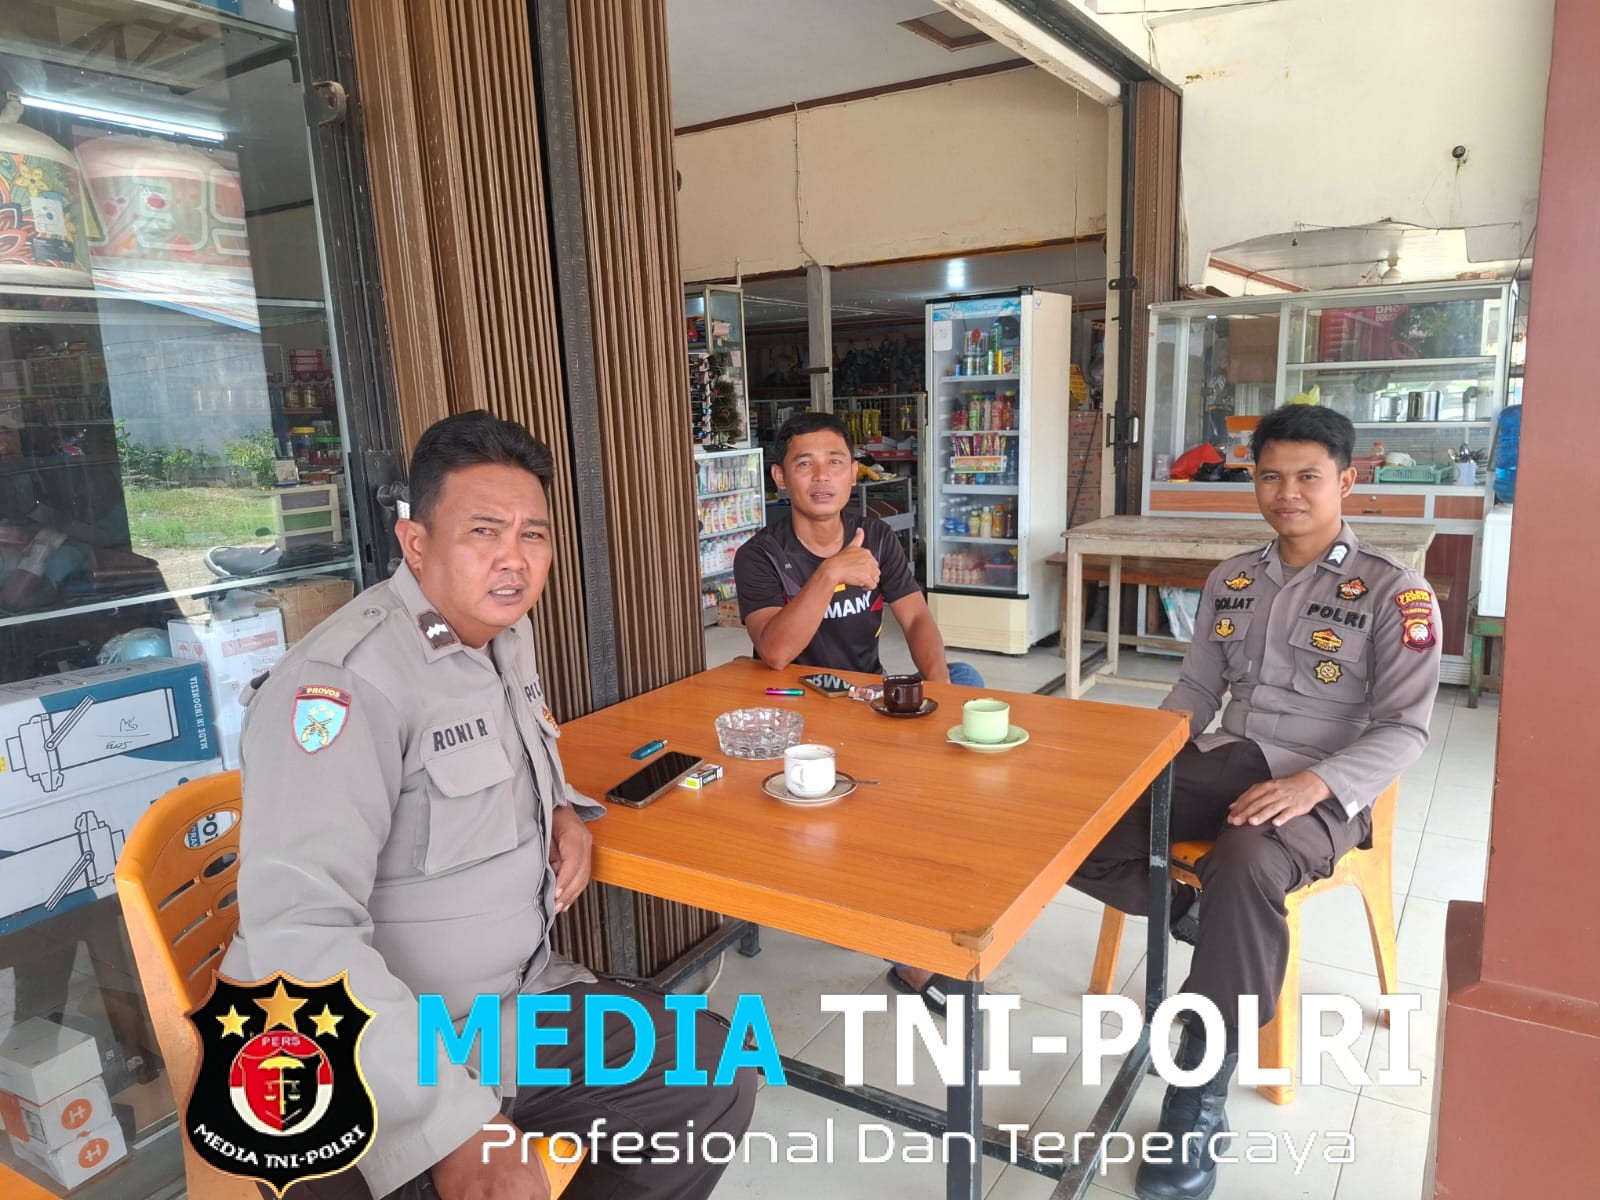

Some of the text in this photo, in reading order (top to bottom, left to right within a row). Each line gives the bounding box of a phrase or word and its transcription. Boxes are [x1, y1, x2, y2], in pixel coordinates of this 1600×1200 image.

[823, 590, 872, 619] MANY
[1306, 603, 1366, 629] POLRI
[306, 687, 340, 698] PROVOS
[190, 676, 209, 750] MADE IN INDONESIA
[432, 718, 488, 752] RONI R
